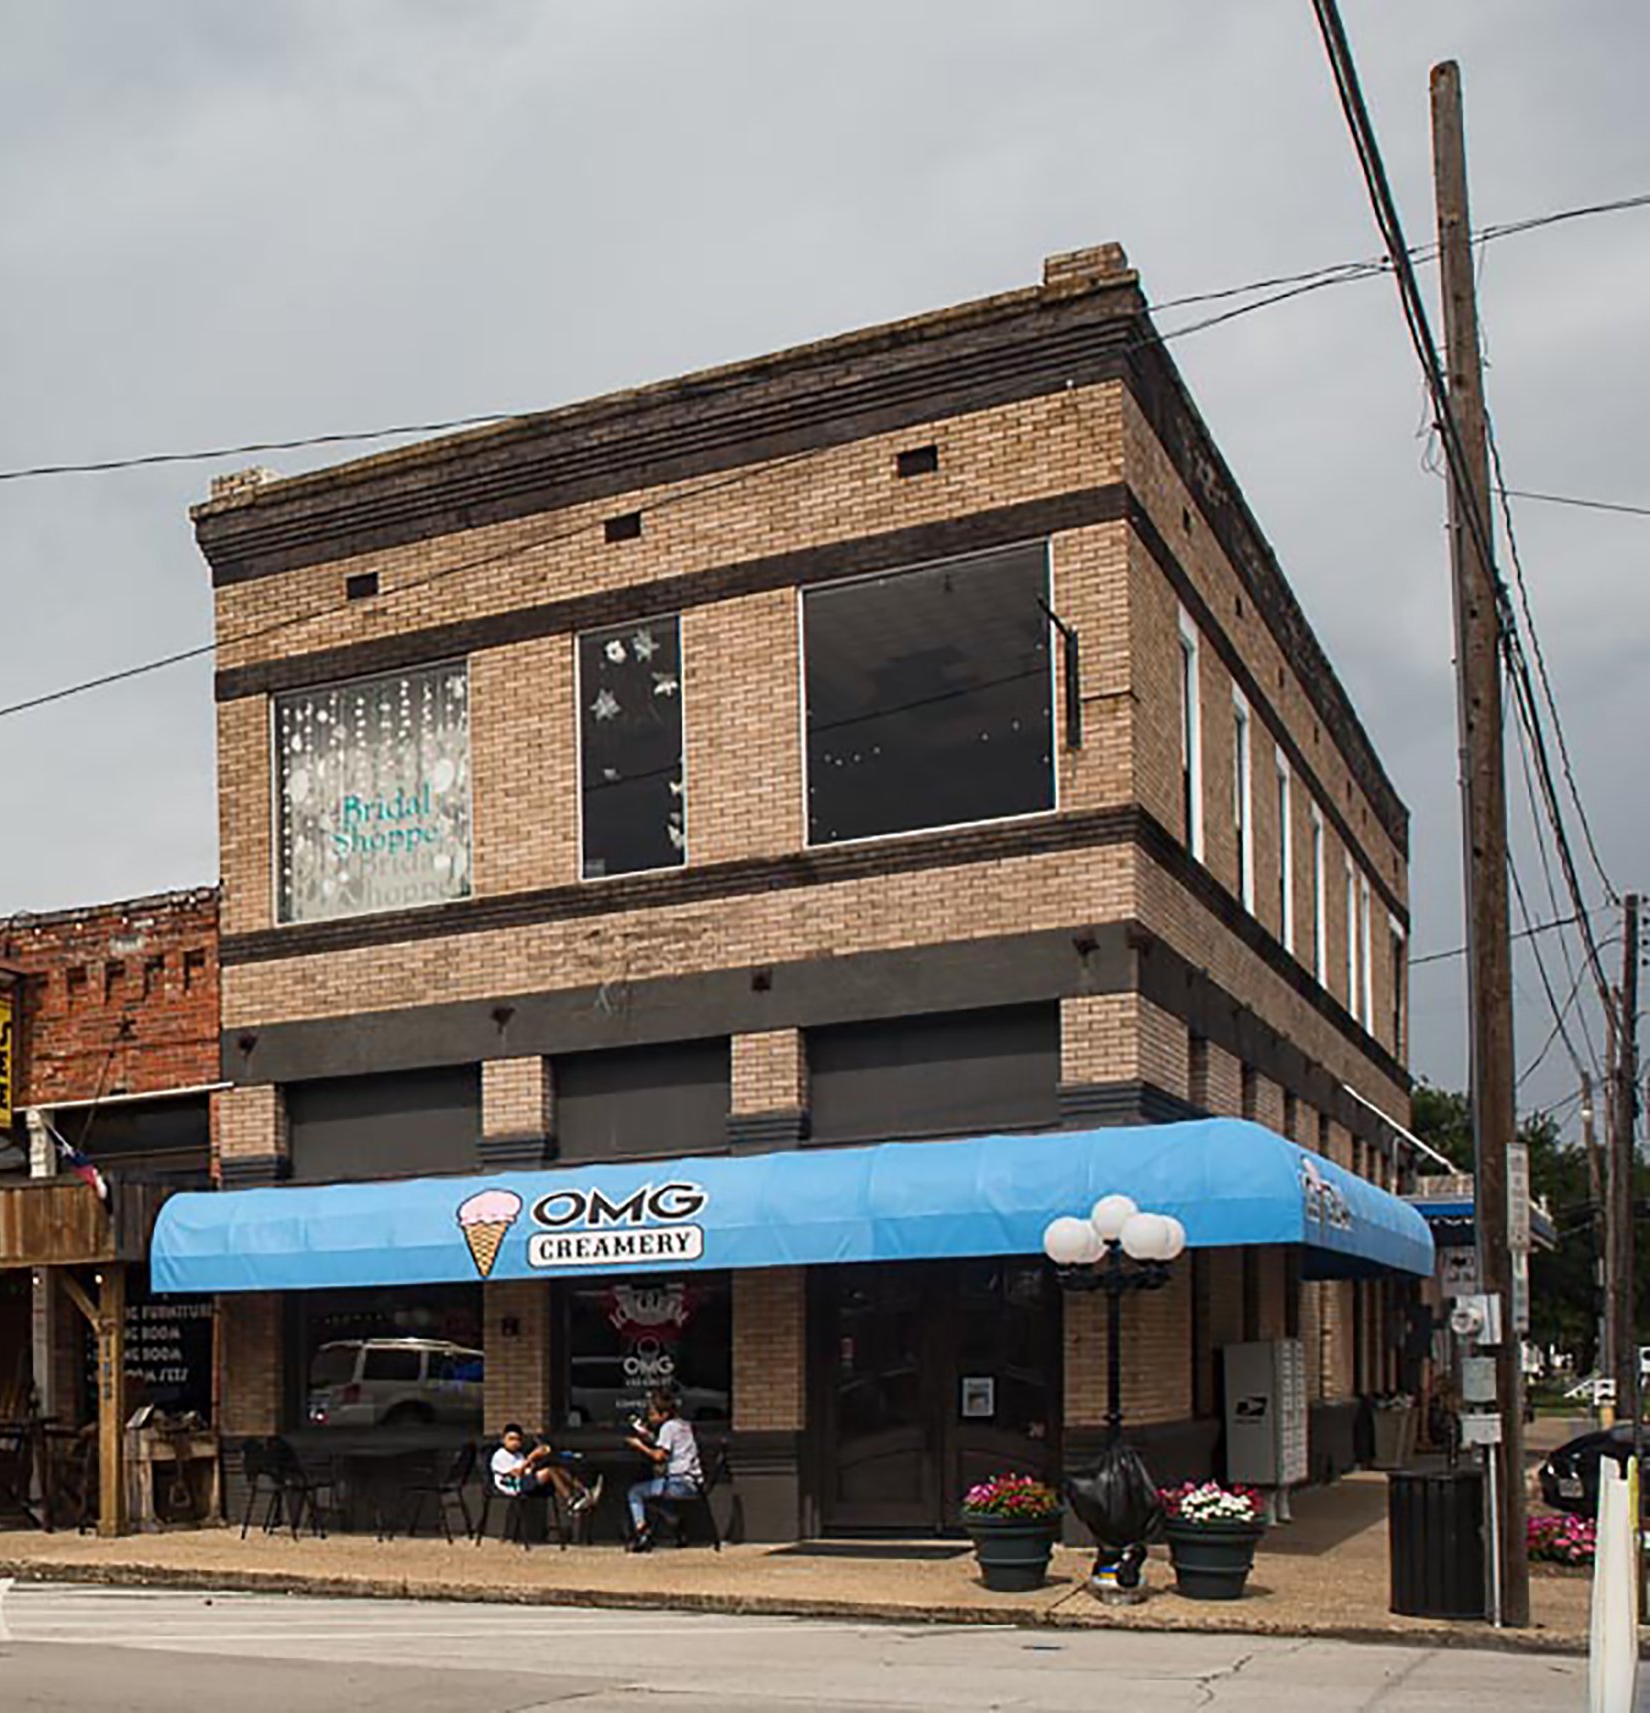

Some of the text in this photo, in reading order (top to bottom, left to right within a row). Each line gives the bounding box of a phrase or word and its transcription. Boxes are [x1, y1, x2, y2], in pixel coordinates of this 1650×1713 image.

[342, 782, 431, 821] Bridal
[330, 824, 439, 857] Shoppe
[531, 1183, 706, 1228] OMG
[538, 1230, 693, 1261] CREAMERY
[622, 1355, 675, 1376] OMG
